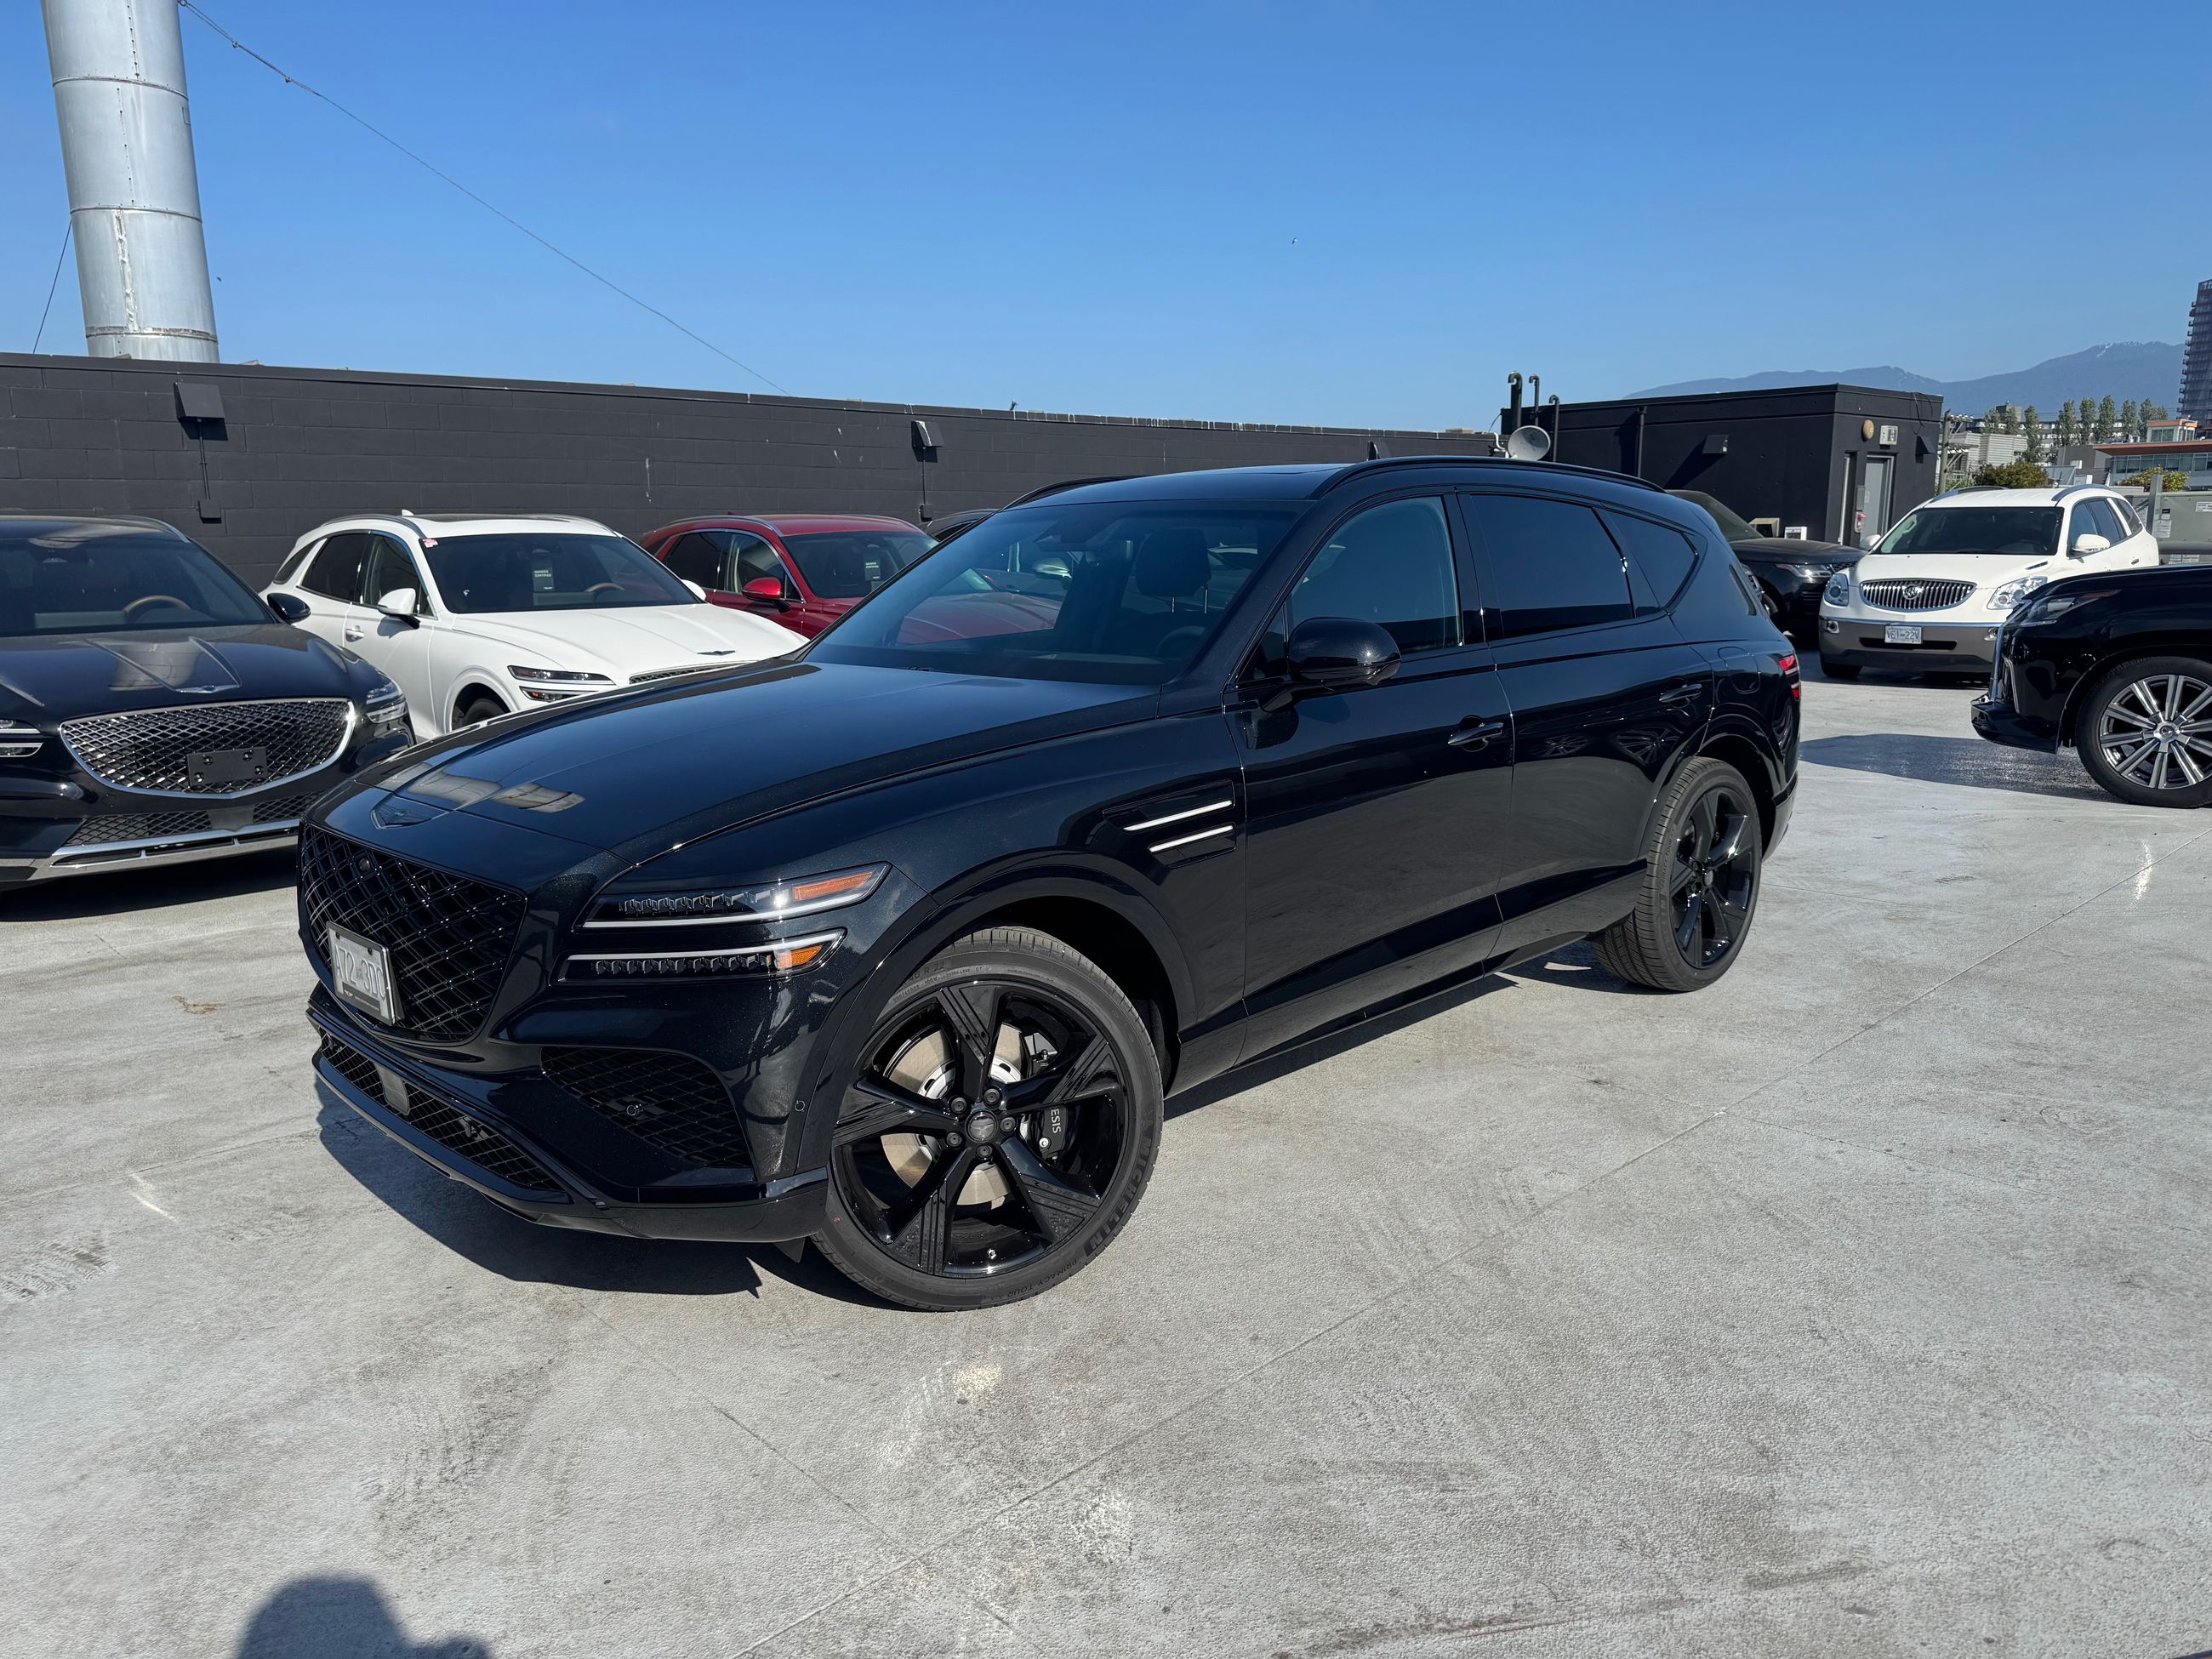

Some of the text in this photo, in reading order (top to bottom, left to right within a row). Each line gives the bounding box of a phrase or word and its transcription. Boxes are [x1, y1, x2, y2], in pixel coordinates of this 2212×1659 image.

[1089, 1134, 1152, 1248] MICHELIN
[1039, 1259, 1077, 1285] PRIMACY
[1007, 1286, 1034, 1297] TOUR
